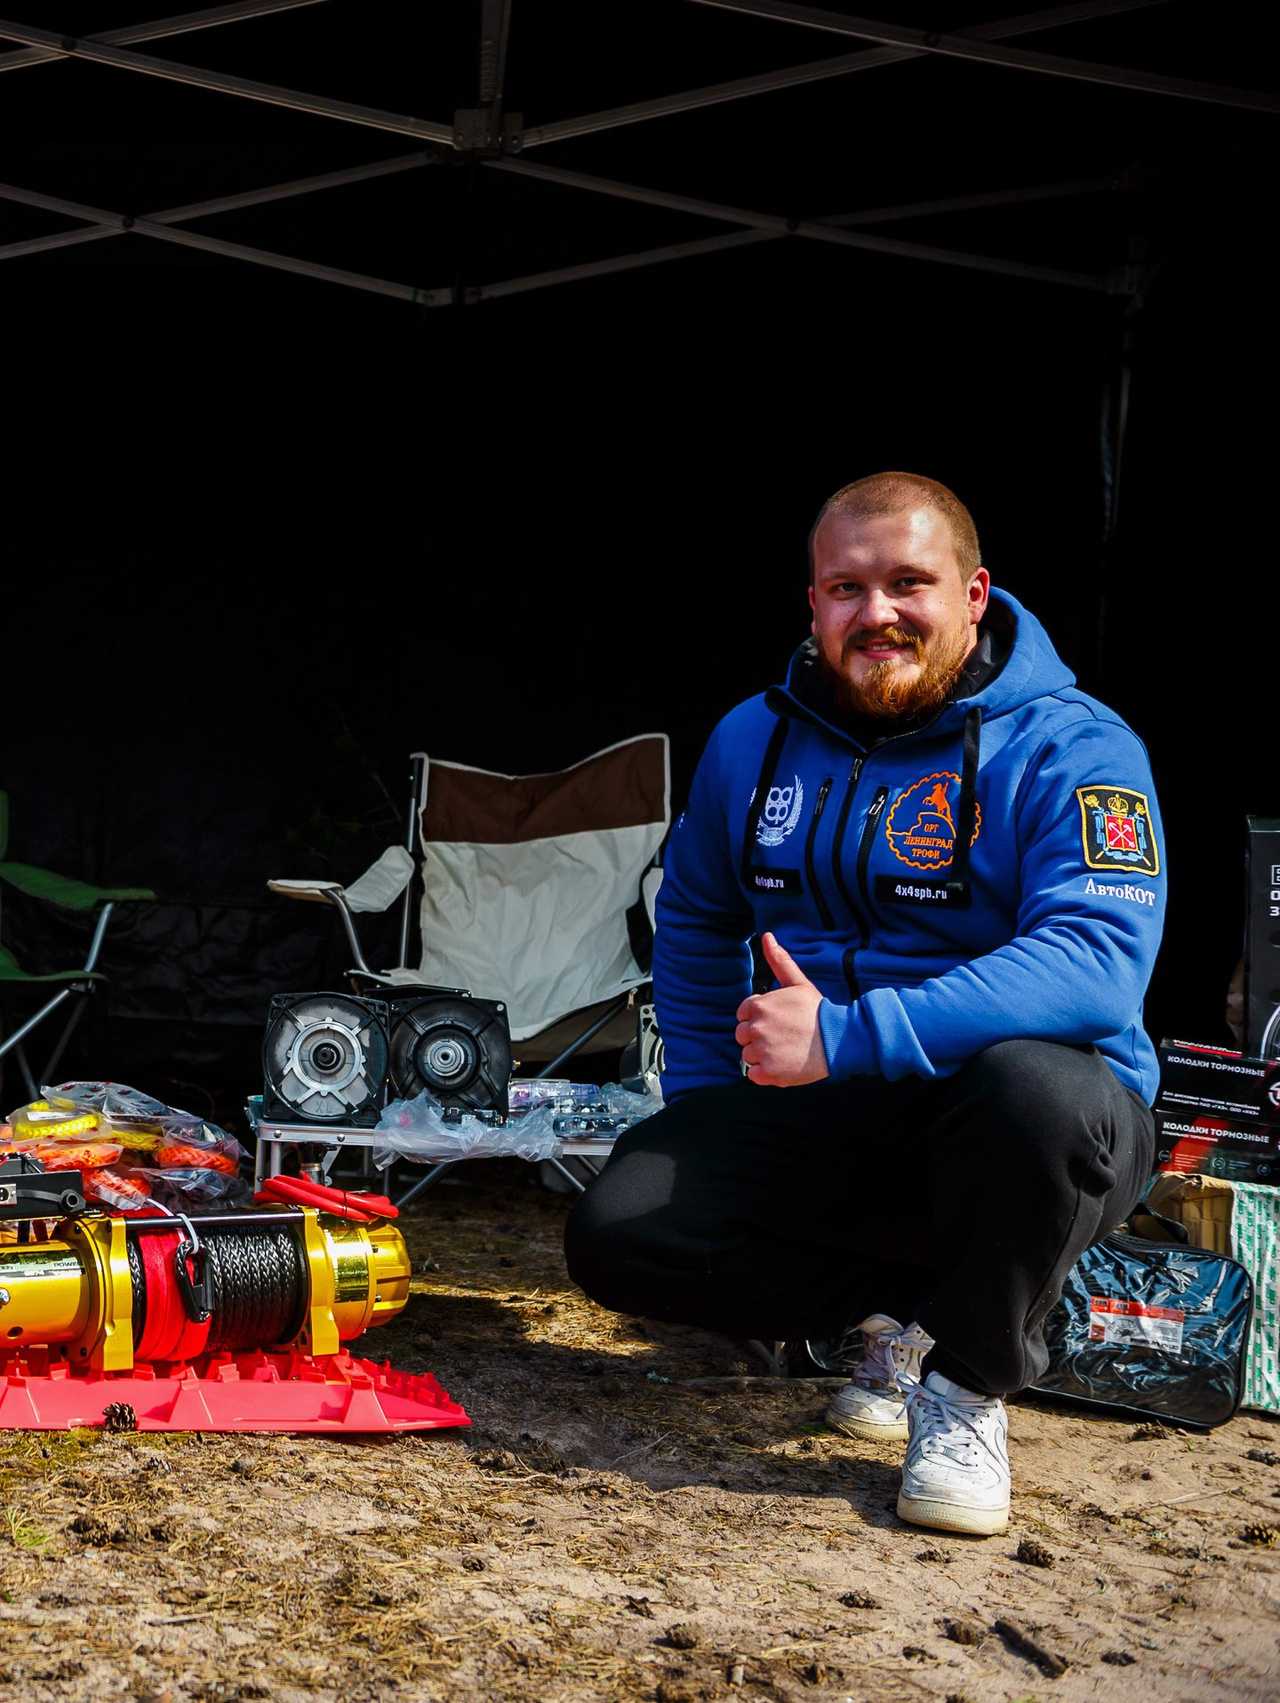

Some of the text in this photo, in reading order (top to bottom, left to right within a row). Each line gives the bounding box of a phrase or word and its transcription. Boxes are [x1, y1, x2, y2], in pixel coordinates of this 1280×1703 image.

[924, 823, 940, 834] ОРГ
[903, 836, 954, 851] ЛЕНИНГРАД
[911, 848, 940, 860] ТРОФИ
[895, 884, 948, 900] 4x4spb.ru
[1167, 1055, 1265, 1077] КОЛОДКИ ТОРМОЗНЫЕ
[1163, 1121, 1269, 1143] КОЛОДКИ ТОРМОЗНЫЕ
